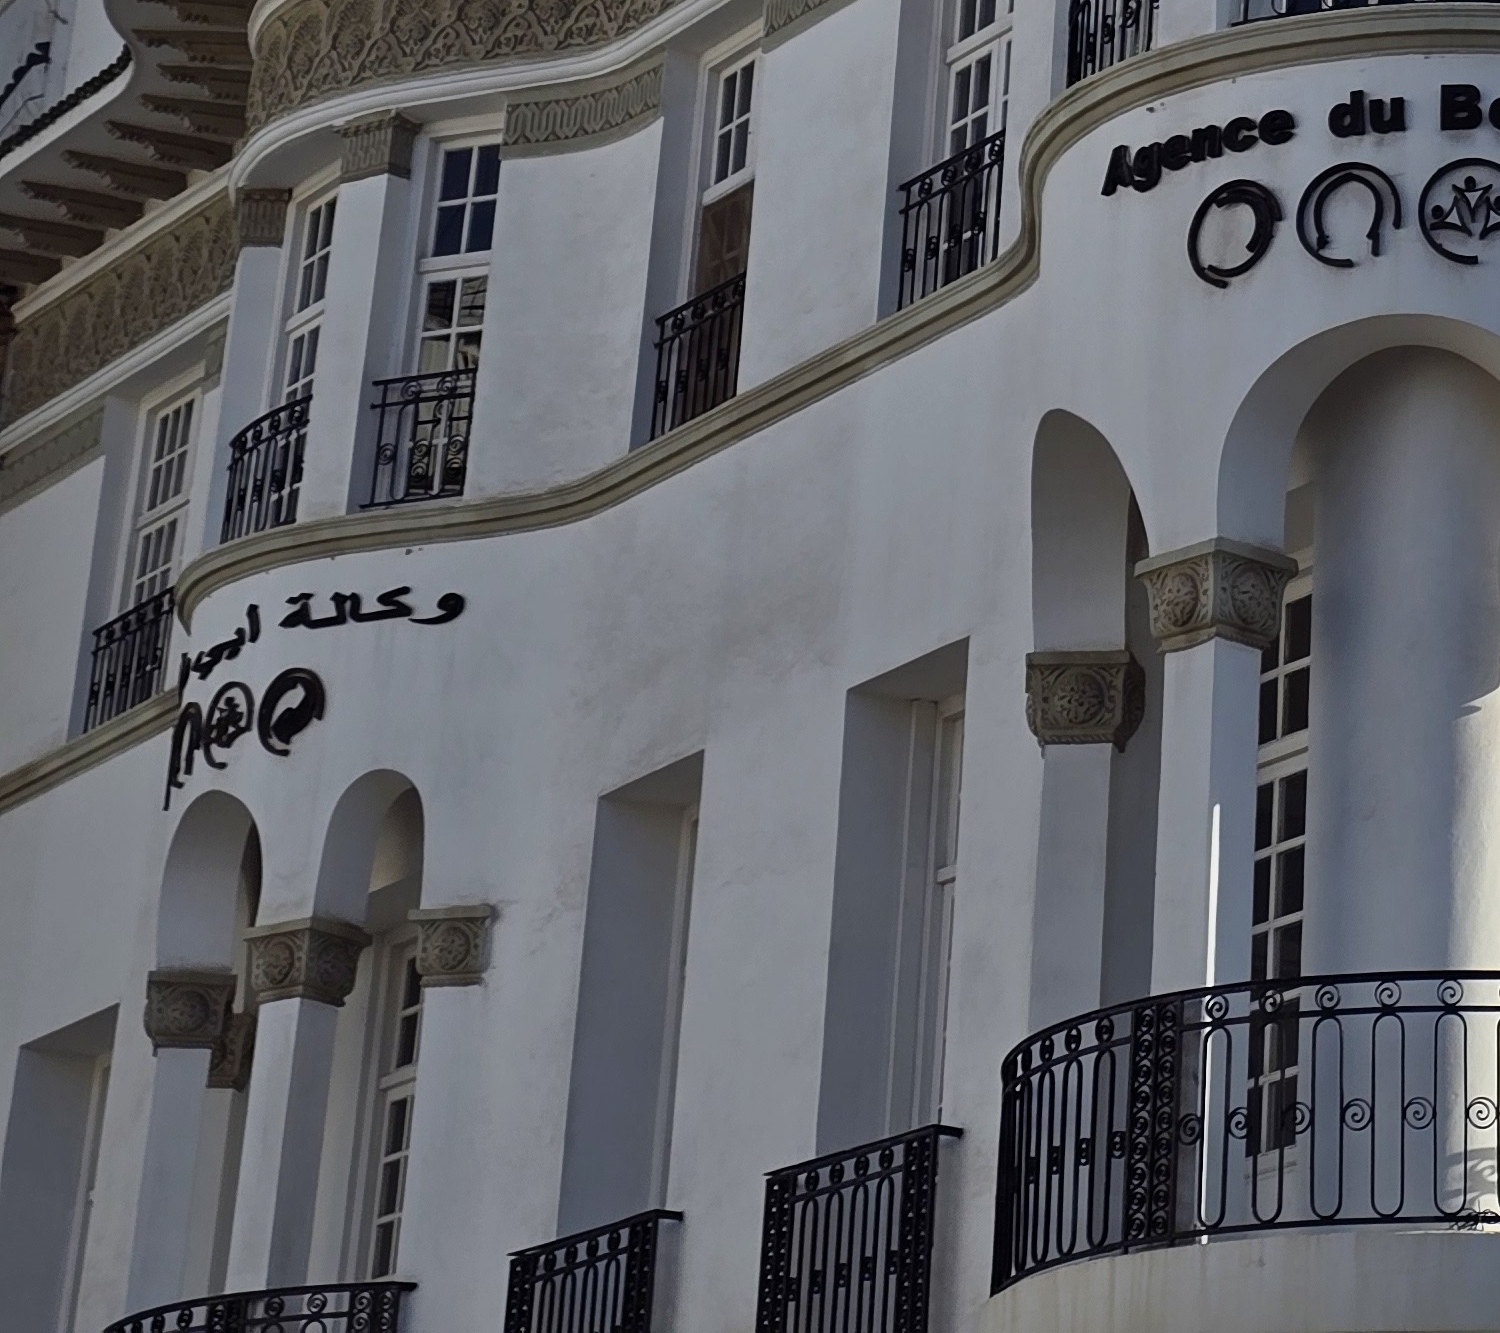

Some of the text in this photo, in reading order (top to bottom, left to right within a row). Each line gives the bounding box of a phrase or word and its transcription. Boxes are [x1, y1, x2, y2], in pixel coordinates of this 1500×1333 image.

[1101, 107, 1298, 196] Agence
[1328, 89, 1408, 138] du
[278, 585, 467, 629] وكالة
